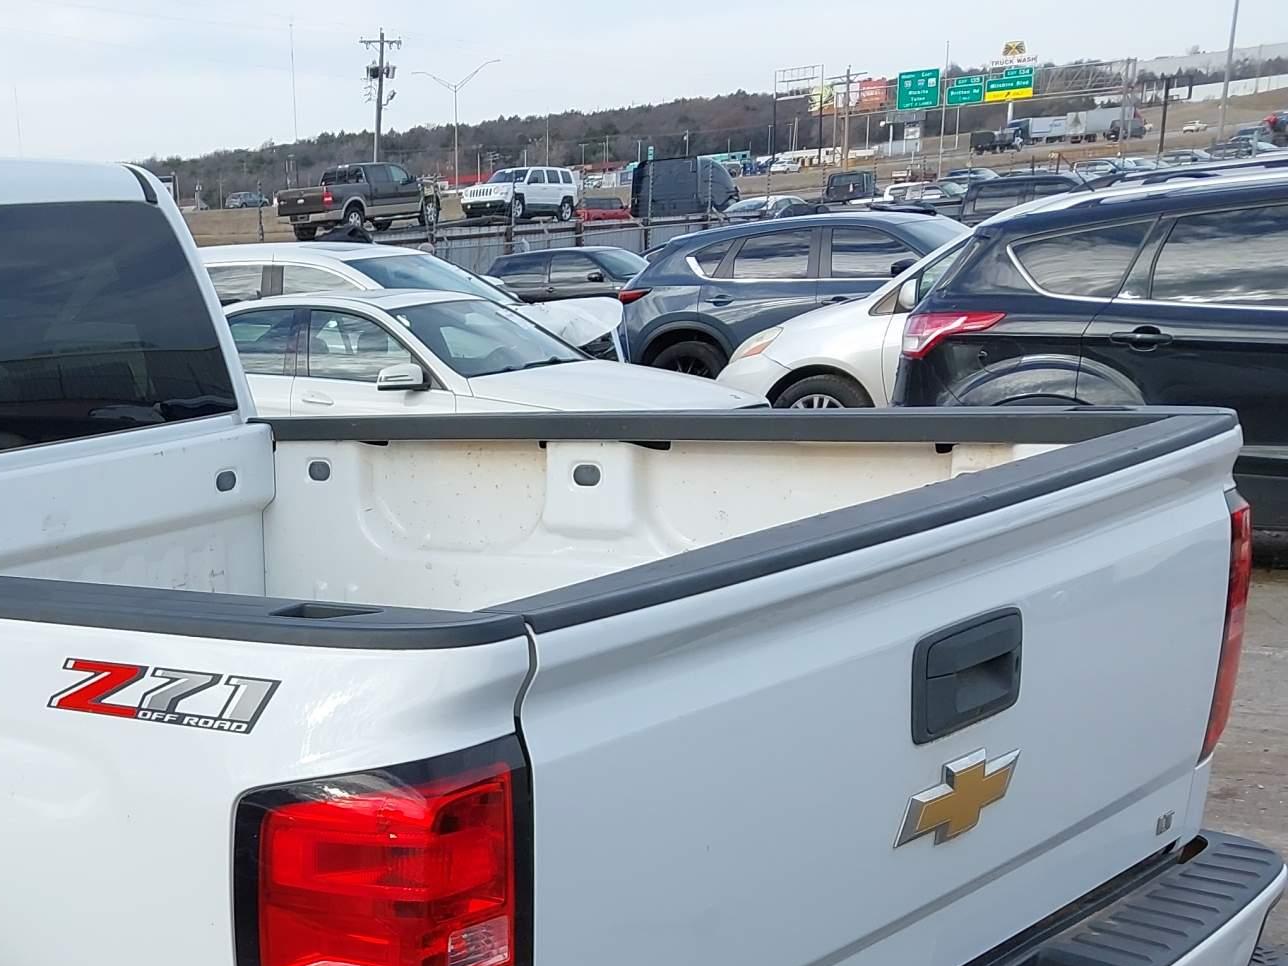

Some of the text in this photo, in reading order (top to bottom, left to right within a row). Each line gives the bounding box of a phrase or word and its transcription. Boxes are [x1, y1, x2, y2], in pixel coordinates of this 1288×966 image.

[992, 56, 1036, 67] TRUCK WASH
[47, 657, 282, 728] Z71
[137, 711, 248, 733] OFF ROAD
